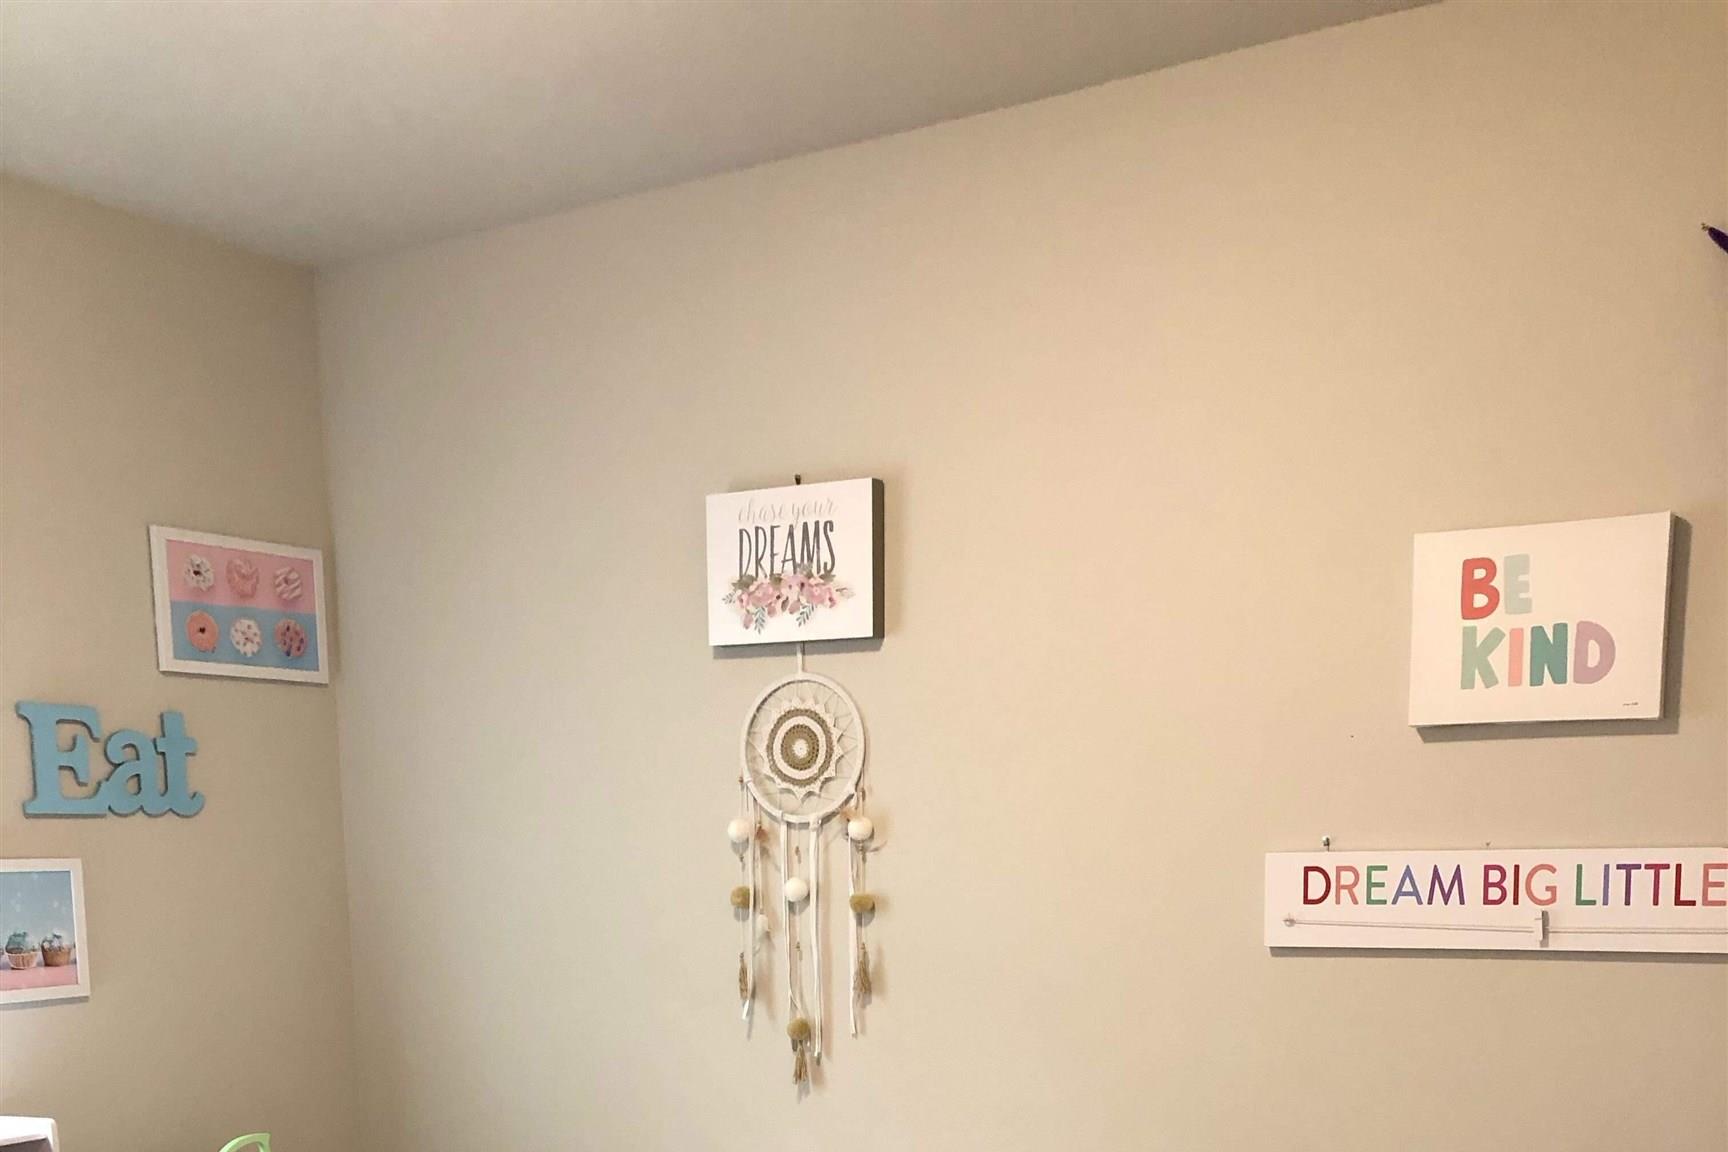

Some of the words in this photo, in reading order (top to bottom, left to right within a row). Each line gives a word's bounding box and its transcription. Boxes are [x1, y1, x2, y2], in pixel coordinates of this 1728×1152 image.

[738, 499, 787, 524] chase
[791, 497, 840, 528] your
[738, 519, 837, 580] DREAMS
[1460, 553, 1533, 620] BE
[1460, 620, 1617, 690] KIND
[15, 700, 206, 819] Eat
[1302, 864, 1466, 906] DREAM
[1482, 863, 1558, 906] BIG
[1574, 863, 1728, 906] LITTLE
